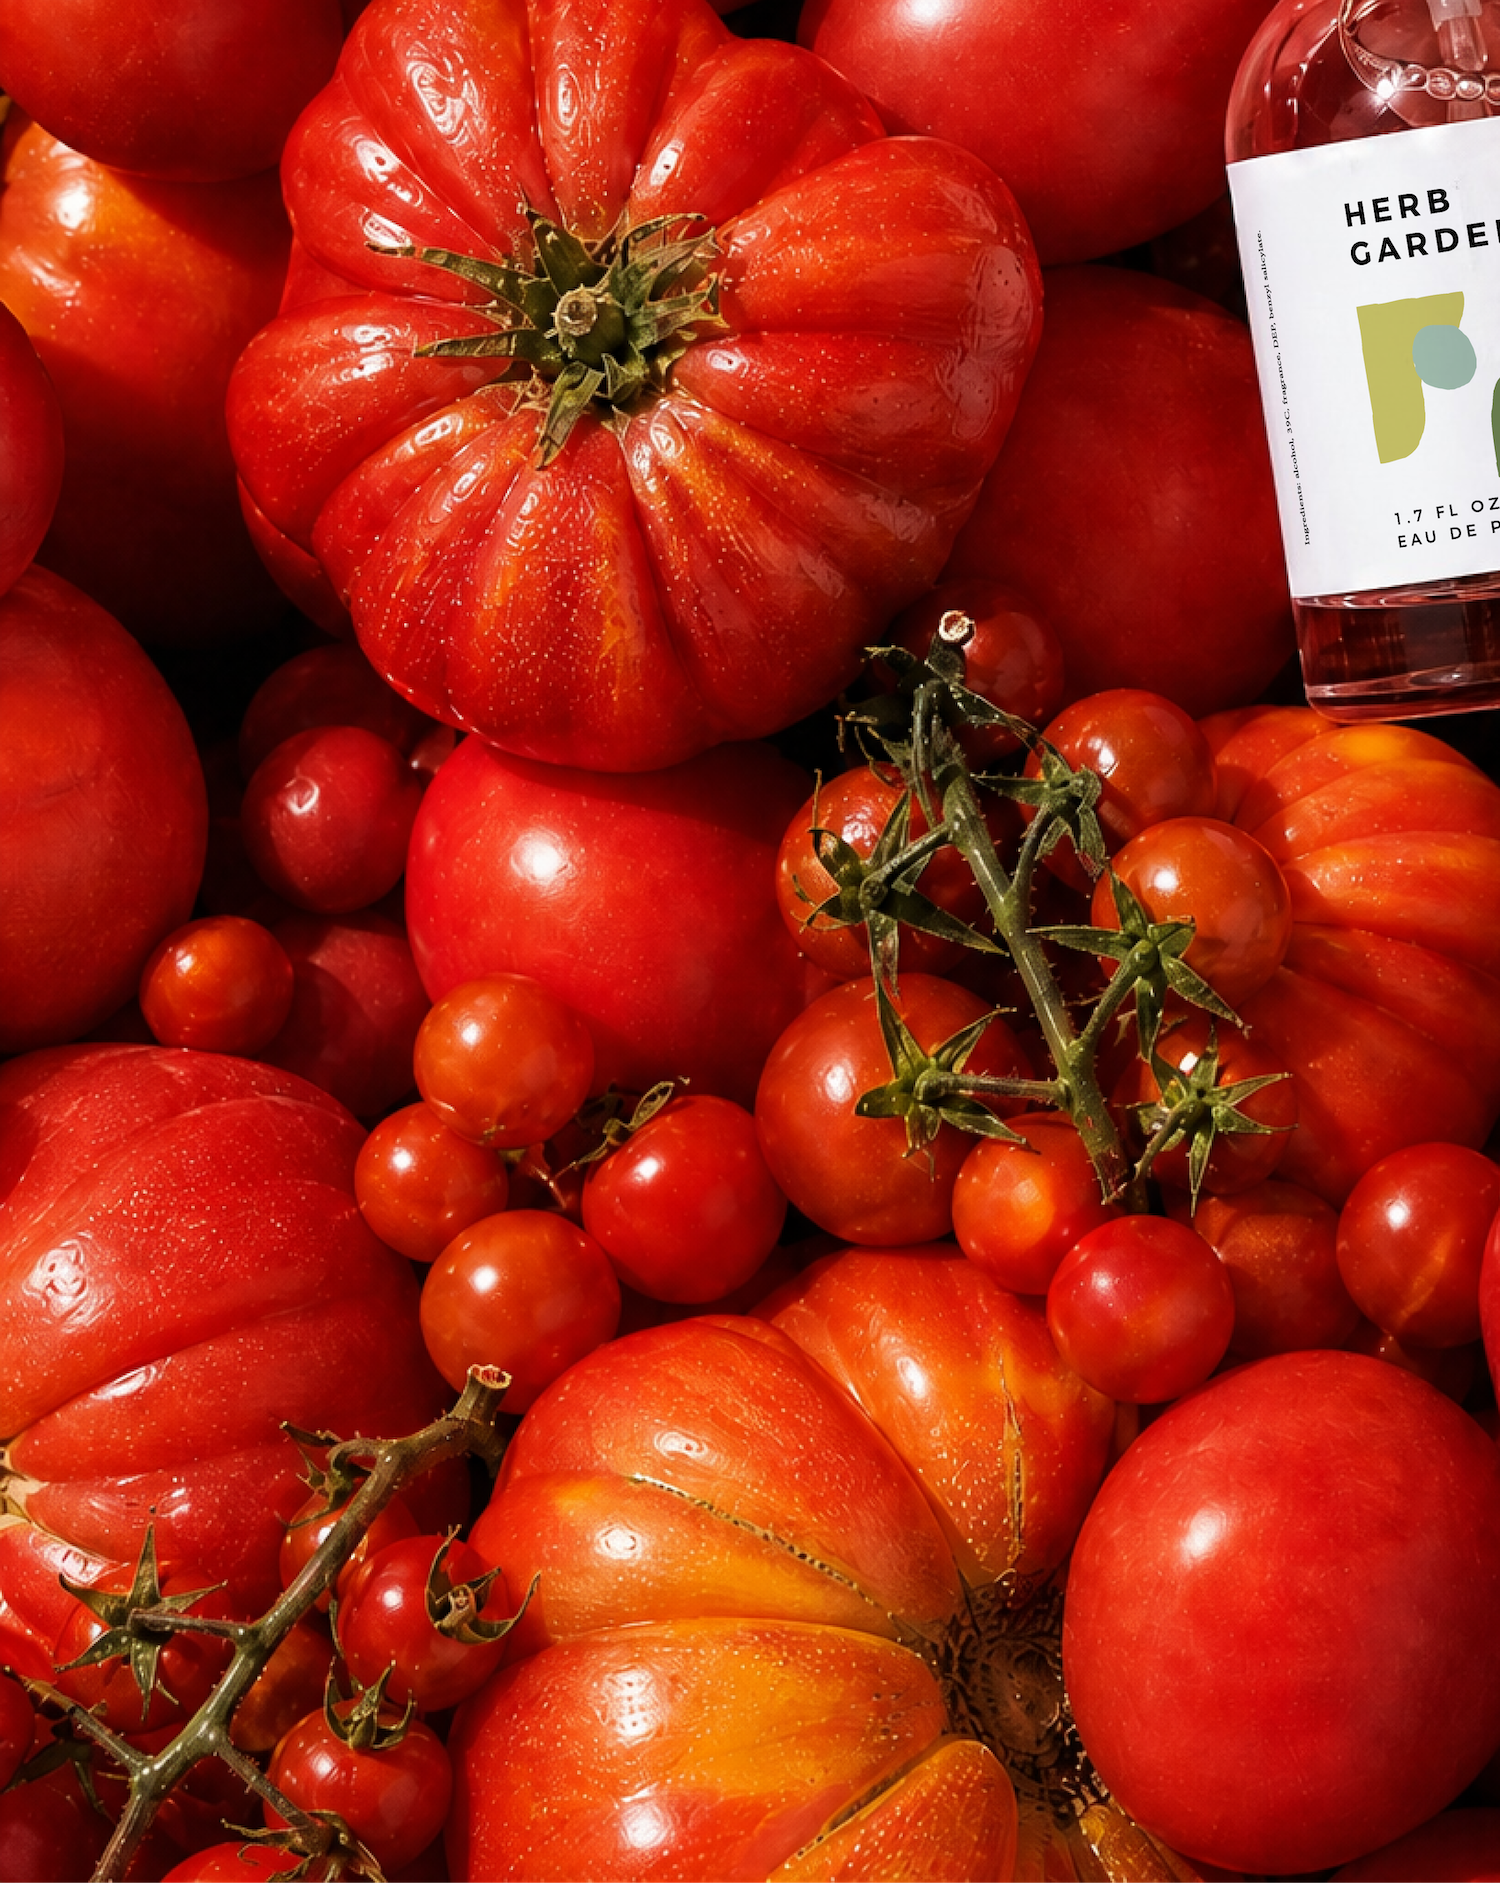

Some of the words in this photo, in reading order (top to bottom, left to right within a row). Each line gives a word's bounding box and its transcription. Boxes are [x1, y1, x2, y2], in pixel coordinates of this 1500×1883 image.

[1344, 188, 1450, 228] HERB
[1257, 230, 1269, 281] salicylate.
[1263, 284, 1274, 319] benzyl
[1270, 322, 1279, 348] DEP,
[1276, 352, 1288, 405] fragrance,
[1288, 437, 1300, 479] alcohol,
[1297, 482, 1311, 546] Ingredients:
[1394, 509, 1423, 525] 1.7
[1435, 504, 1459, 519] FL
[1471, 497, 1500, 513] OZ
[1397, 530, 1437, 549] EAU
[1450, 524, 1477, 540] DE
